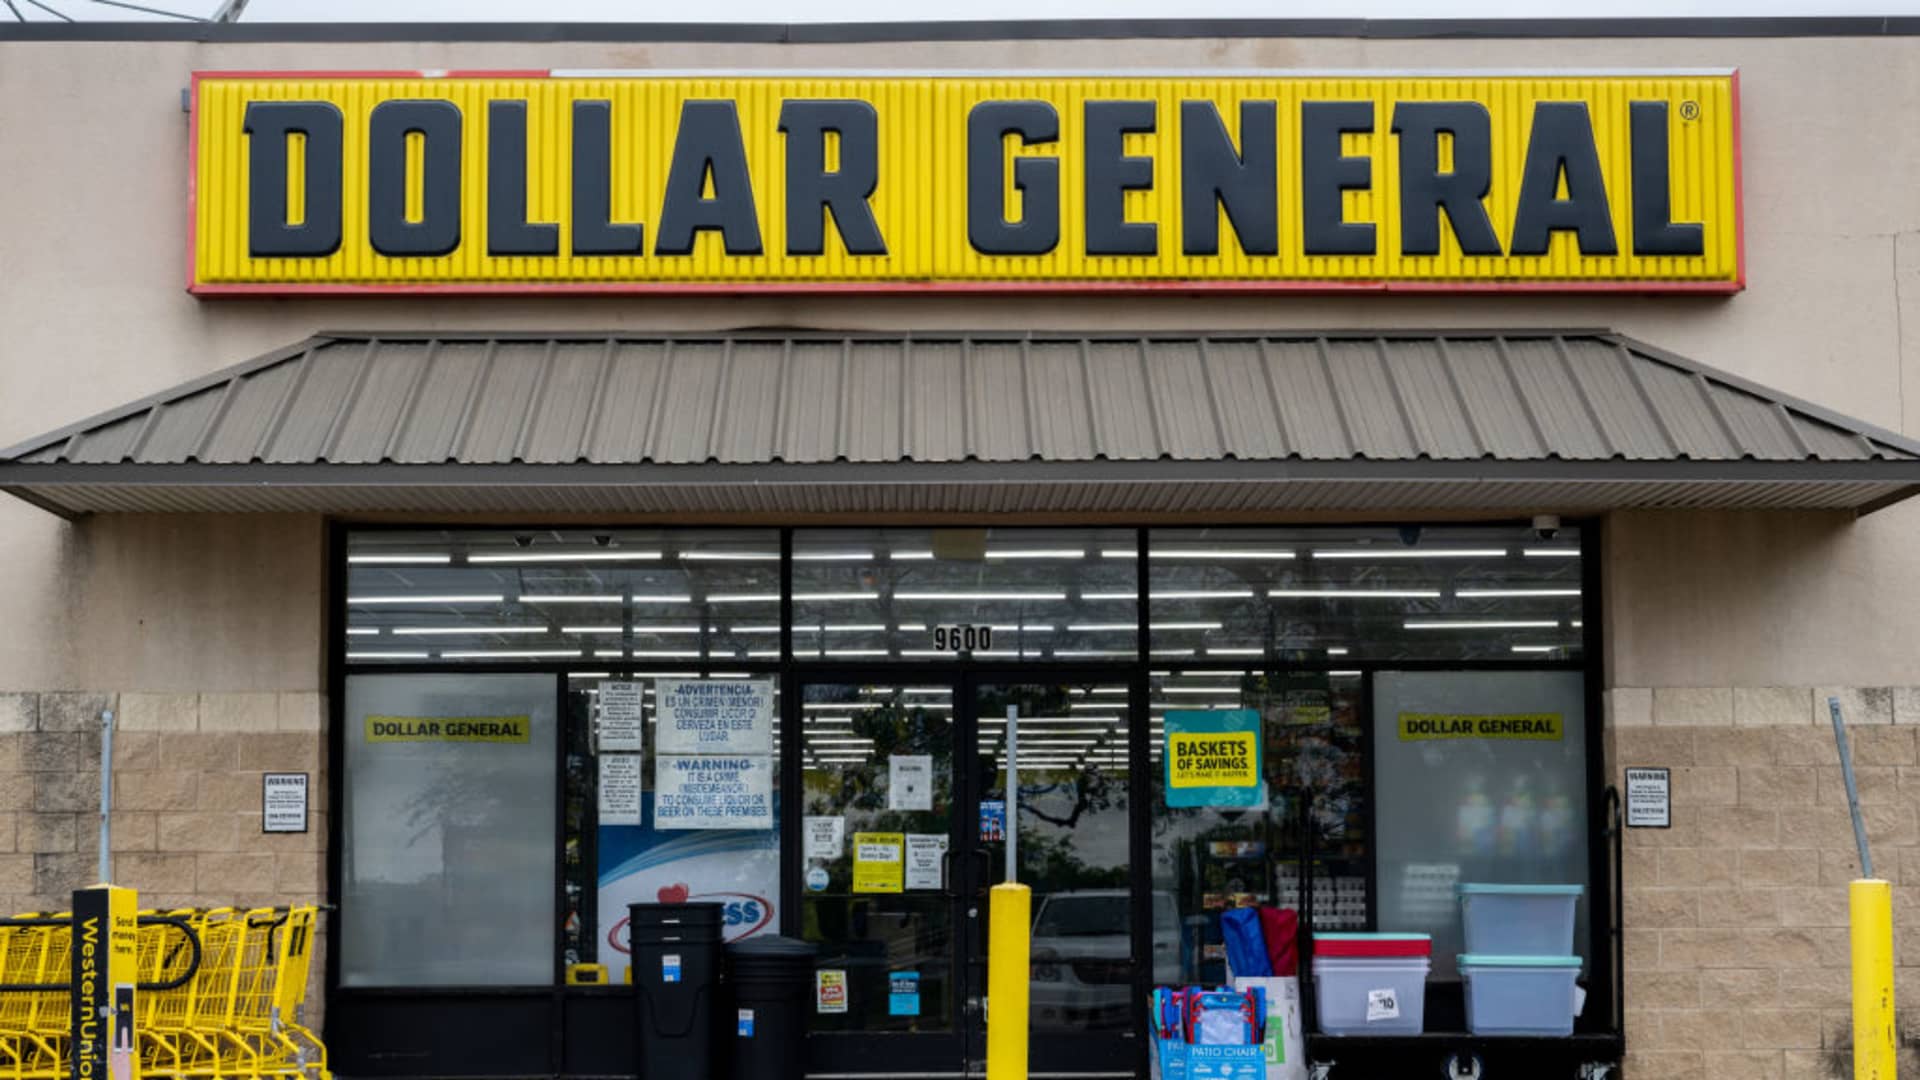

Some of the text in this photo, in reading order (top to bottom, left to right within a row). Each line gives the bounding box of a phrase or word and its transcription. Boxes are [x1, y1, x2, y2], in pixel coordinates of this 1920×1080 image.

[242, 99, 888, 258] DOLLAR
[935, 626, 991, 651] 9600
[373, 722, 523, 736] DOLLAR GENERAL
[1406, 720, 1556, 734] DOLLAR GENERAL
[1176, 741, 1248, 757] BASKETS
[1177, 758, 1193, 770] OF
[658, 806, 681, 817] BEER
[115, 916, 134, 927] Send
[1191, 1048, 1221, 1057] PATIO
[1223, 1048, 1257, 1057] CHAIR
